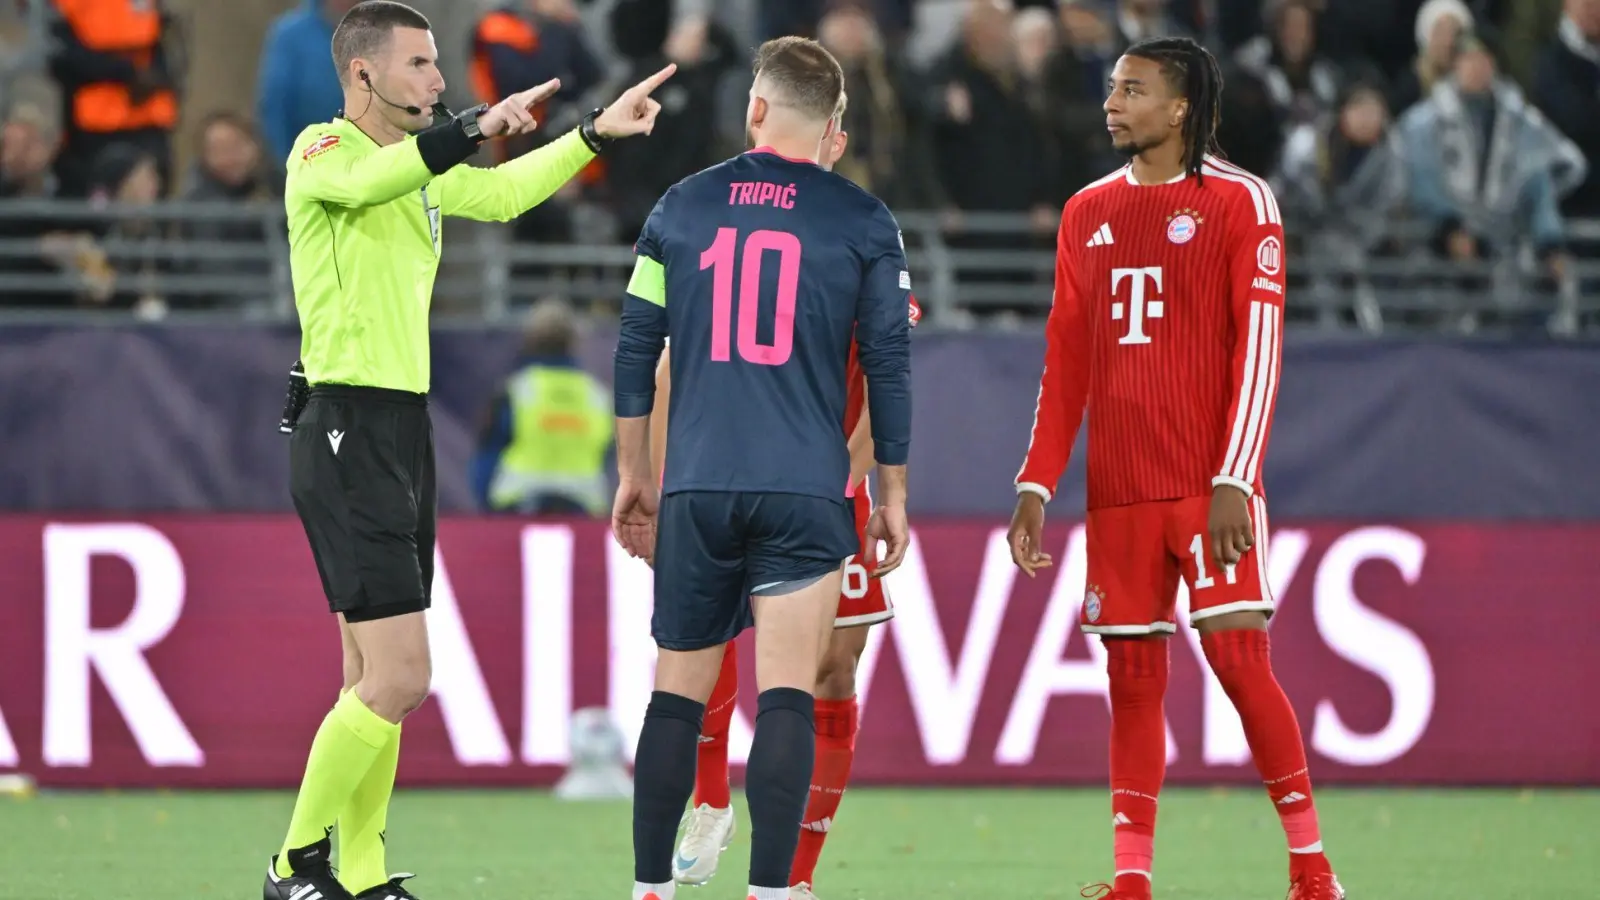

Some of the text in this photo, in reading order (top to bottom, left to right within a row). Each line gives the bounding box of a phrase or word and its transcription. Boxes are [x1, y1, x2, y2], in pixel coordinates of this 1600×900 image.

[729, 181, 797, 209] TRIPIĆ
[699, 227, 802, 366] 10
[1252, 277, 1282, 294] Allianz
[0, 522, 206, 767] R
